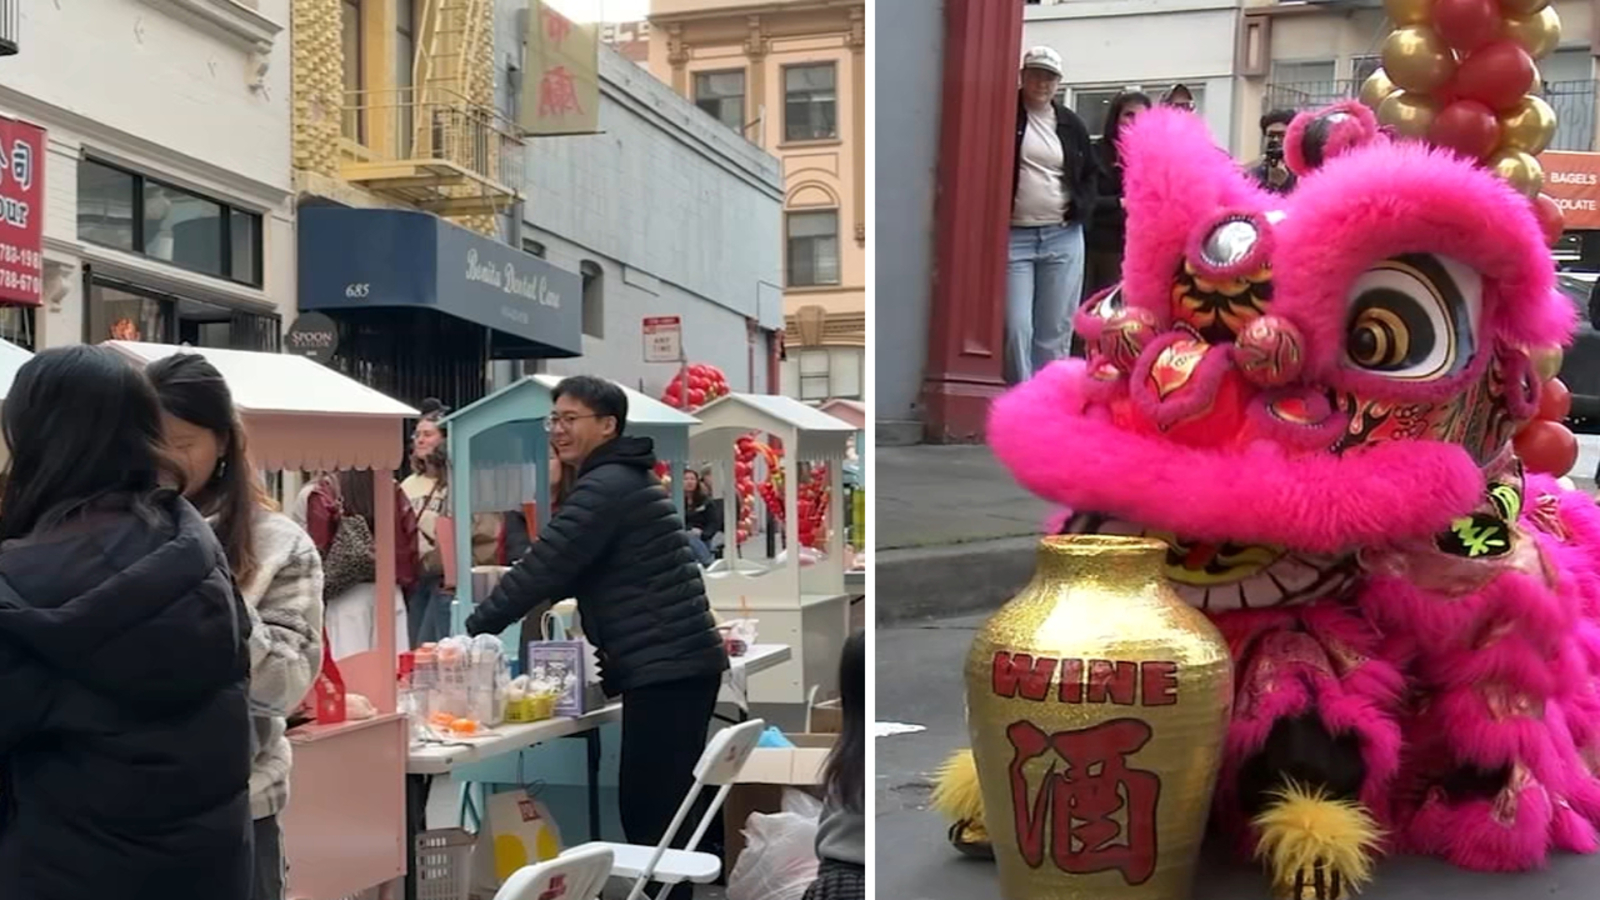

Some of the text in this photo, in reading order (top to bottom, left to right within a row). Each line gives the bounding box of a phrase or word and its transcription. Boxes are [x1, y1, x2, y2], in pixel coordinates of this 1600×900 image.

[0, 138, 31, 191] 司
[1551, 172, 1597, 185] BAGELS
[345, 284, 370, 298] 685
[466, 249, 560, 309] Bonita Dental Care
[292, 331, 333, 341] SPOON
[993, 650, 1178, 706] WINE
[1006, 717, 1161, 886] 酒
